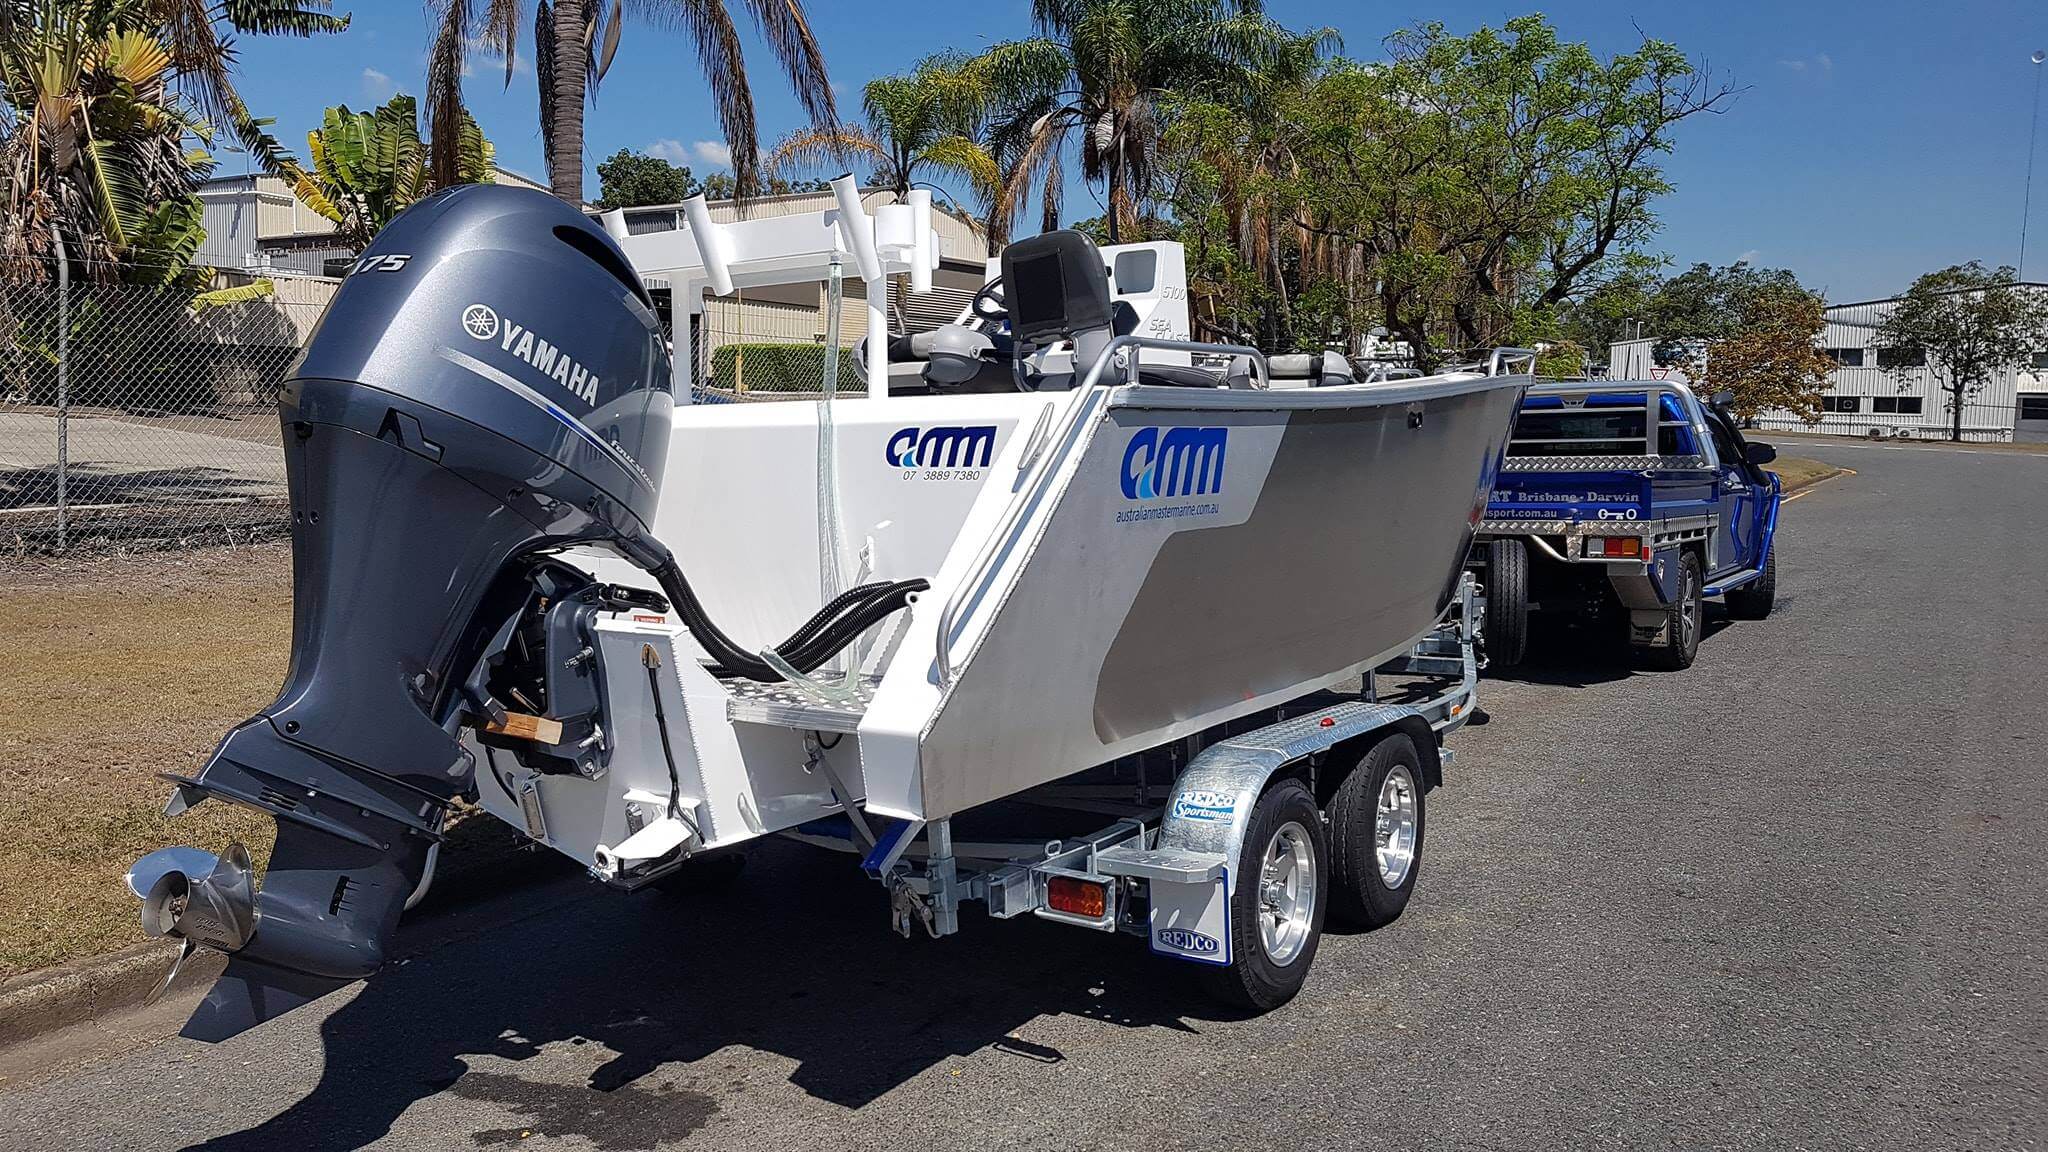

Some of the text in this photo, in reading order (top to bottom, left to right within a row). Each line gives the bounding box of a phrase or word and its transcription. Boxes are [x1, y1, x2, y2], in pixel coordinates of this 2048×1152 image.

[350, 254, 412, 276] 175
[1149, 318, 1172, 332] SEA
[501, 318, 600, 407] YAMAHA
[903, 470, 980, 480] 07 3889 7380
[1518, 492, 1576, 501] Brisbane
[1587, 491, 1639, 502] Darwin
[1116, 502, 1219, 522] australianmastermarine.com.au
[1173, 802, 1233, 820] Sportsman
